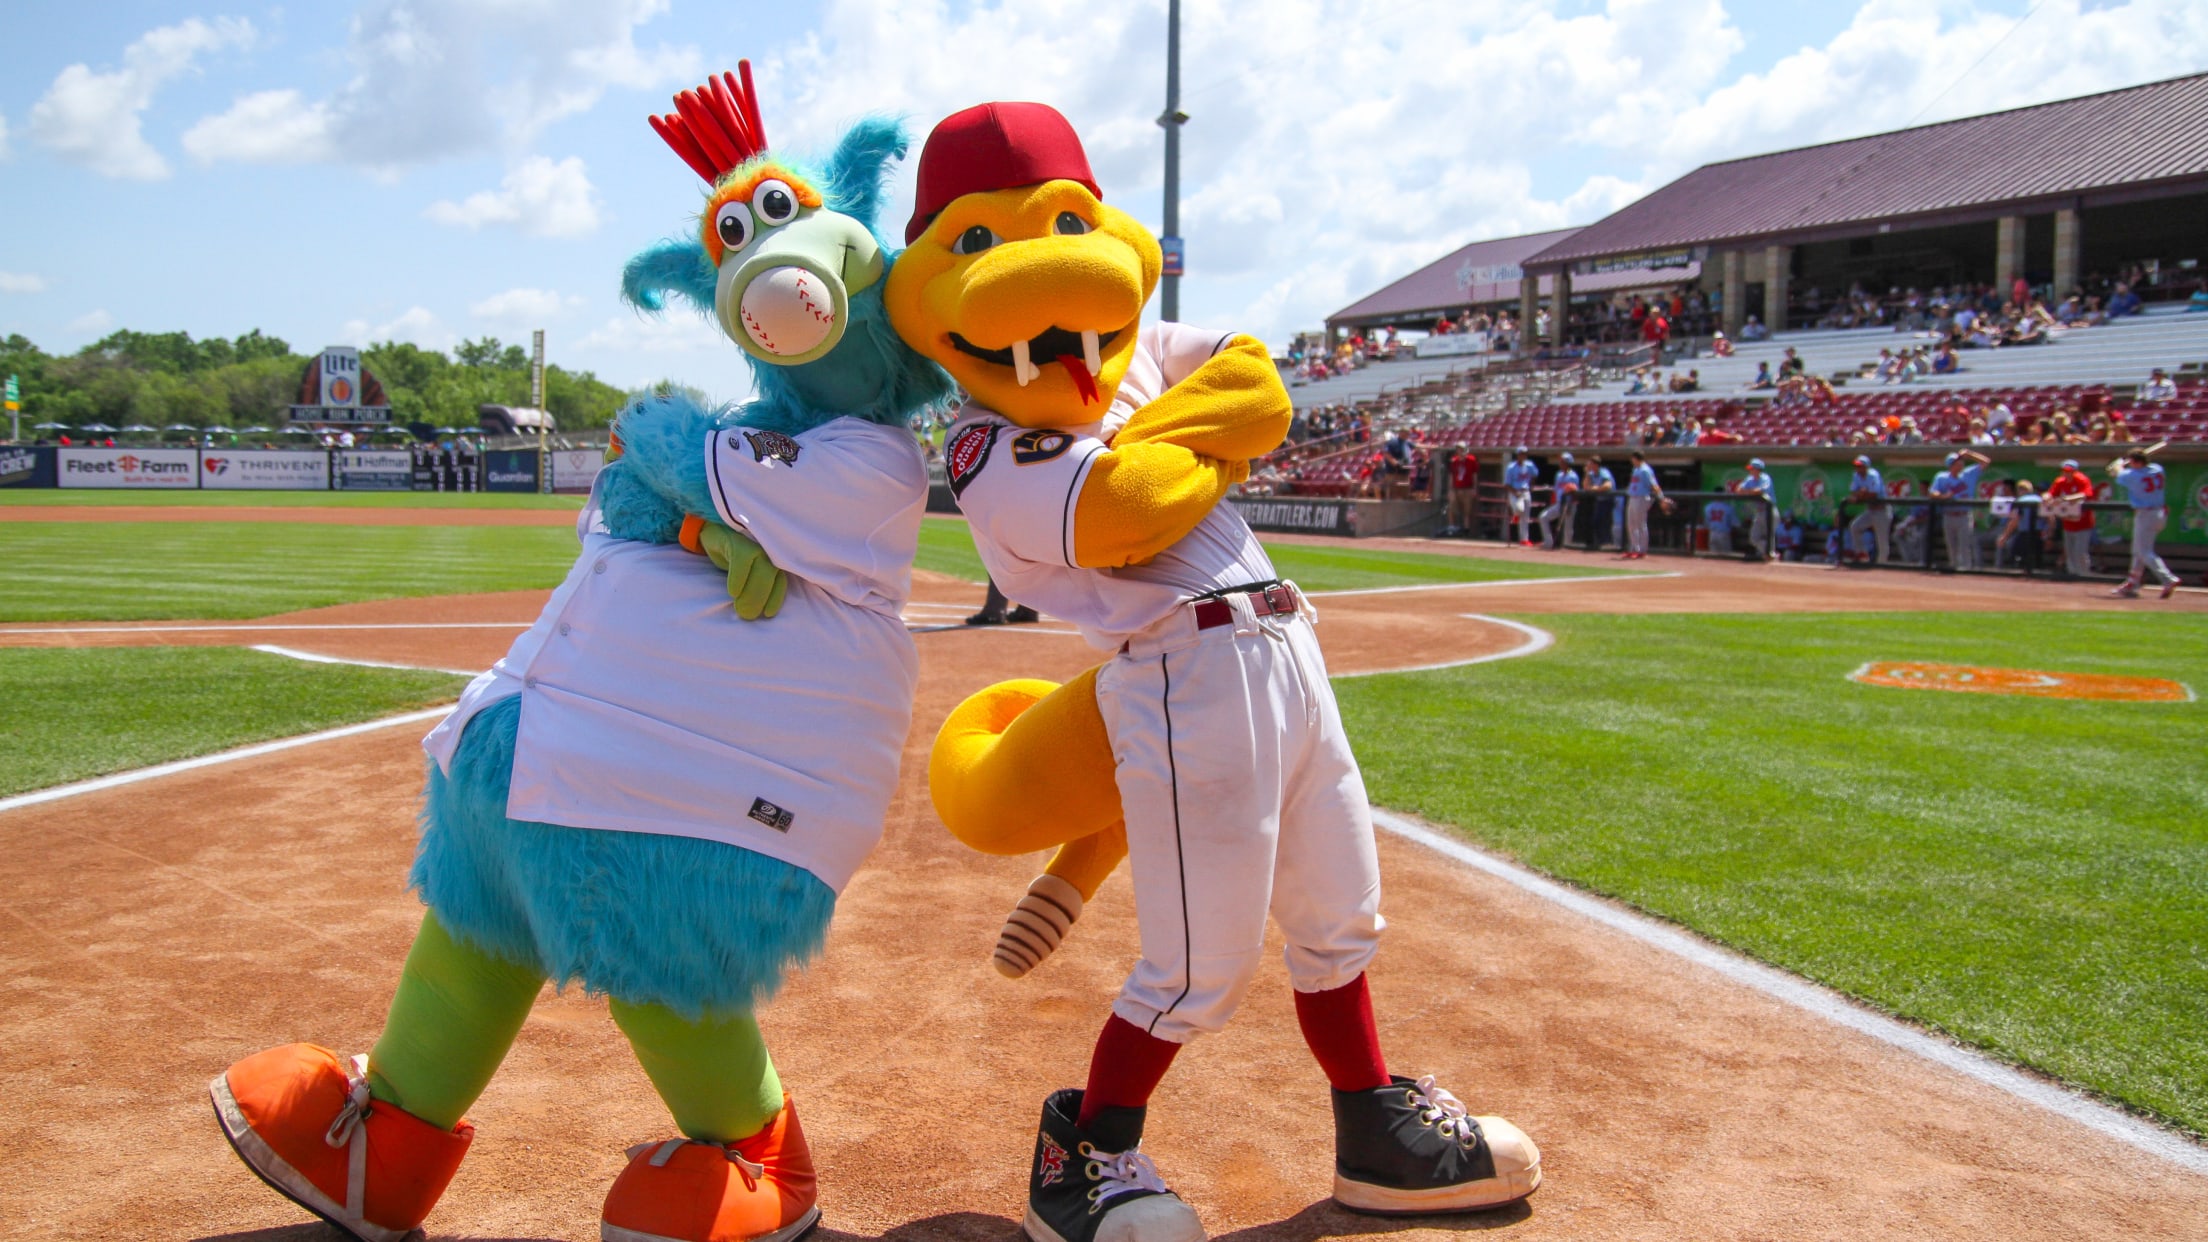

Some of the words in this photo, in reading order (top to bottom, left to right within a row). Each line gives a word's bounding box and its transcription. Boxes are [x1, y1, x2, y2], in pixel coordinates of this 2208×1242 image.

[325, 355, 357, 376] Lite
[296, 408, 322, 420] HOME
[329, 408, 349, 420] RUN
[353, 408, 387, 420] PORCH
[955, 431, 982, 463] Dairy
[958, 434, 985, 471] Queen
[66, 459, 116, 472] Fleet
[141, 460, 188, 472] Farm
[239, 460, 323, 471] THRIVENT
[364, 456, 408, 467] Hoffman
[488, 471, 534, 482] Guardian
